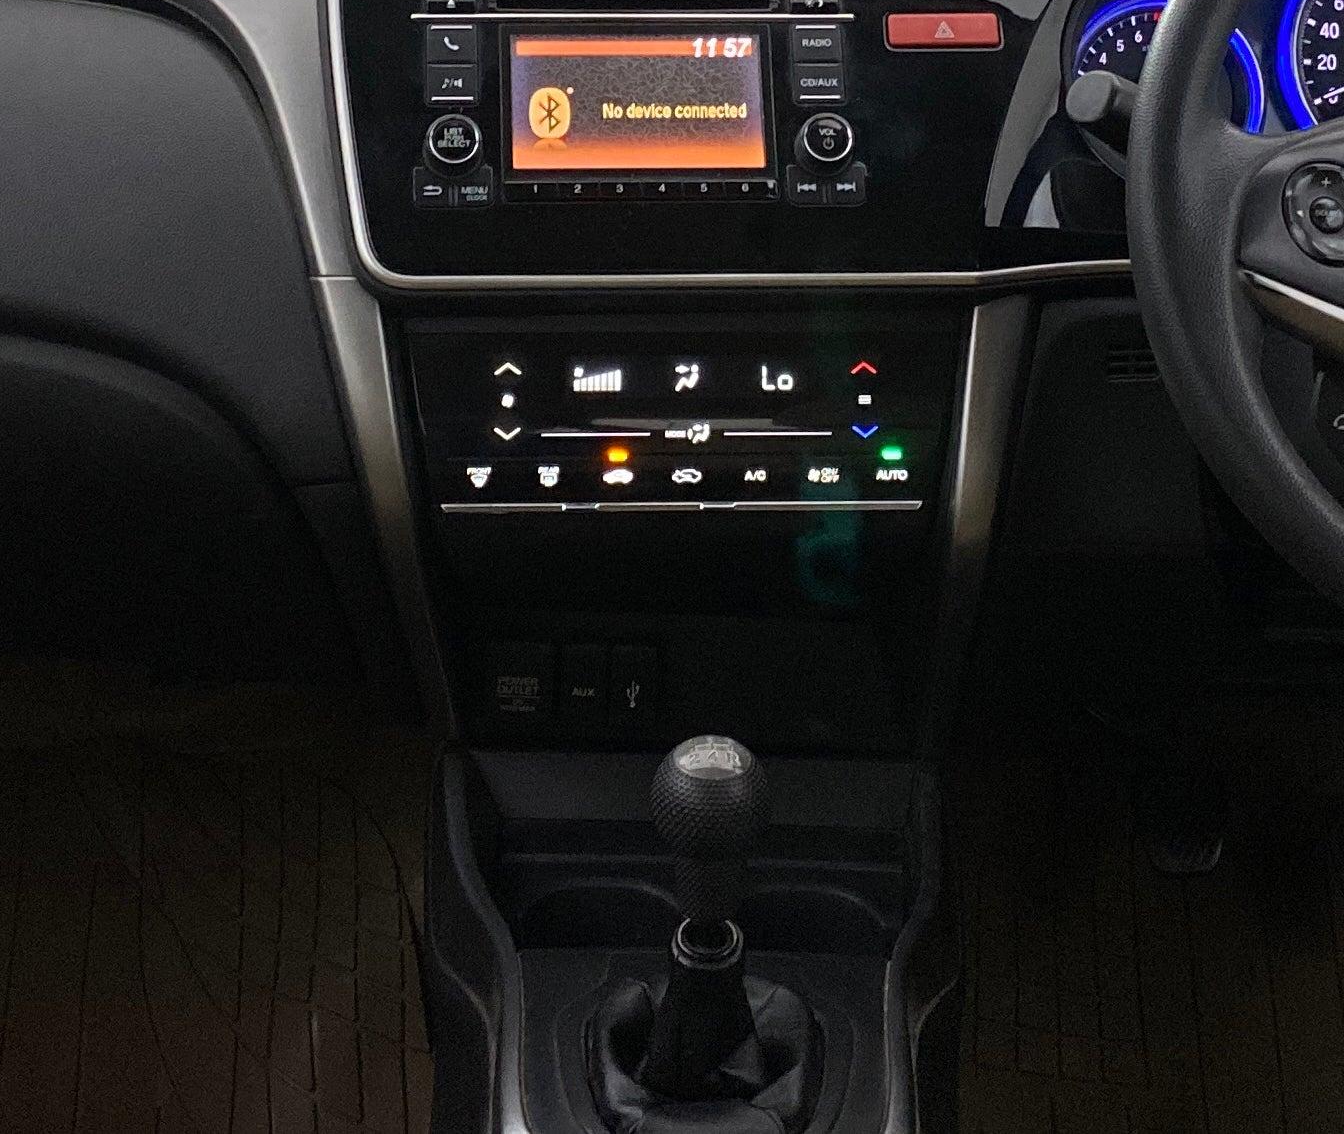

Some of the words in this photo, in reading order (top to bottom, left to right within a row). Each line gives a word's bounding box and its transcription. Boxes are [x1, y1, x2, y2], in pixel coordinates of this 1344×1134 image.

[1319, 22, 1340, 39] 40
[1134, 30, 1143, 43] 6
[801, 38, 832, 47] RADIO
[1116, 39, 1125, 53] 5
[1098, 52, 1107, 65] 4
[1317, 54, 1337, 71] 20
[800, 77, 838, 87] CD/AUX
[602, 103, 623, 119] No
[626, 102, 672, 119] device
[674, 102, 748, 119] connected
[818, 128, 837, 136] VOL
[437, 140, 471, 148] SELECT
[461, 186, 489, 194] MENU
[533, 184, 538, 193] 1
[573, 183, 582, 193] 2
[615, 183, 624, 193] 3
[658, 183, 666, 193] 4
[700, 183, 708, 193] 5
[741, 183, 750, 193] 6
[761, 365, 794, 391] Lo
[744, 470, 767, 481] A/C
[875, 469, 909, 481] AUTO
[571, 687, 596, 697] AUX
